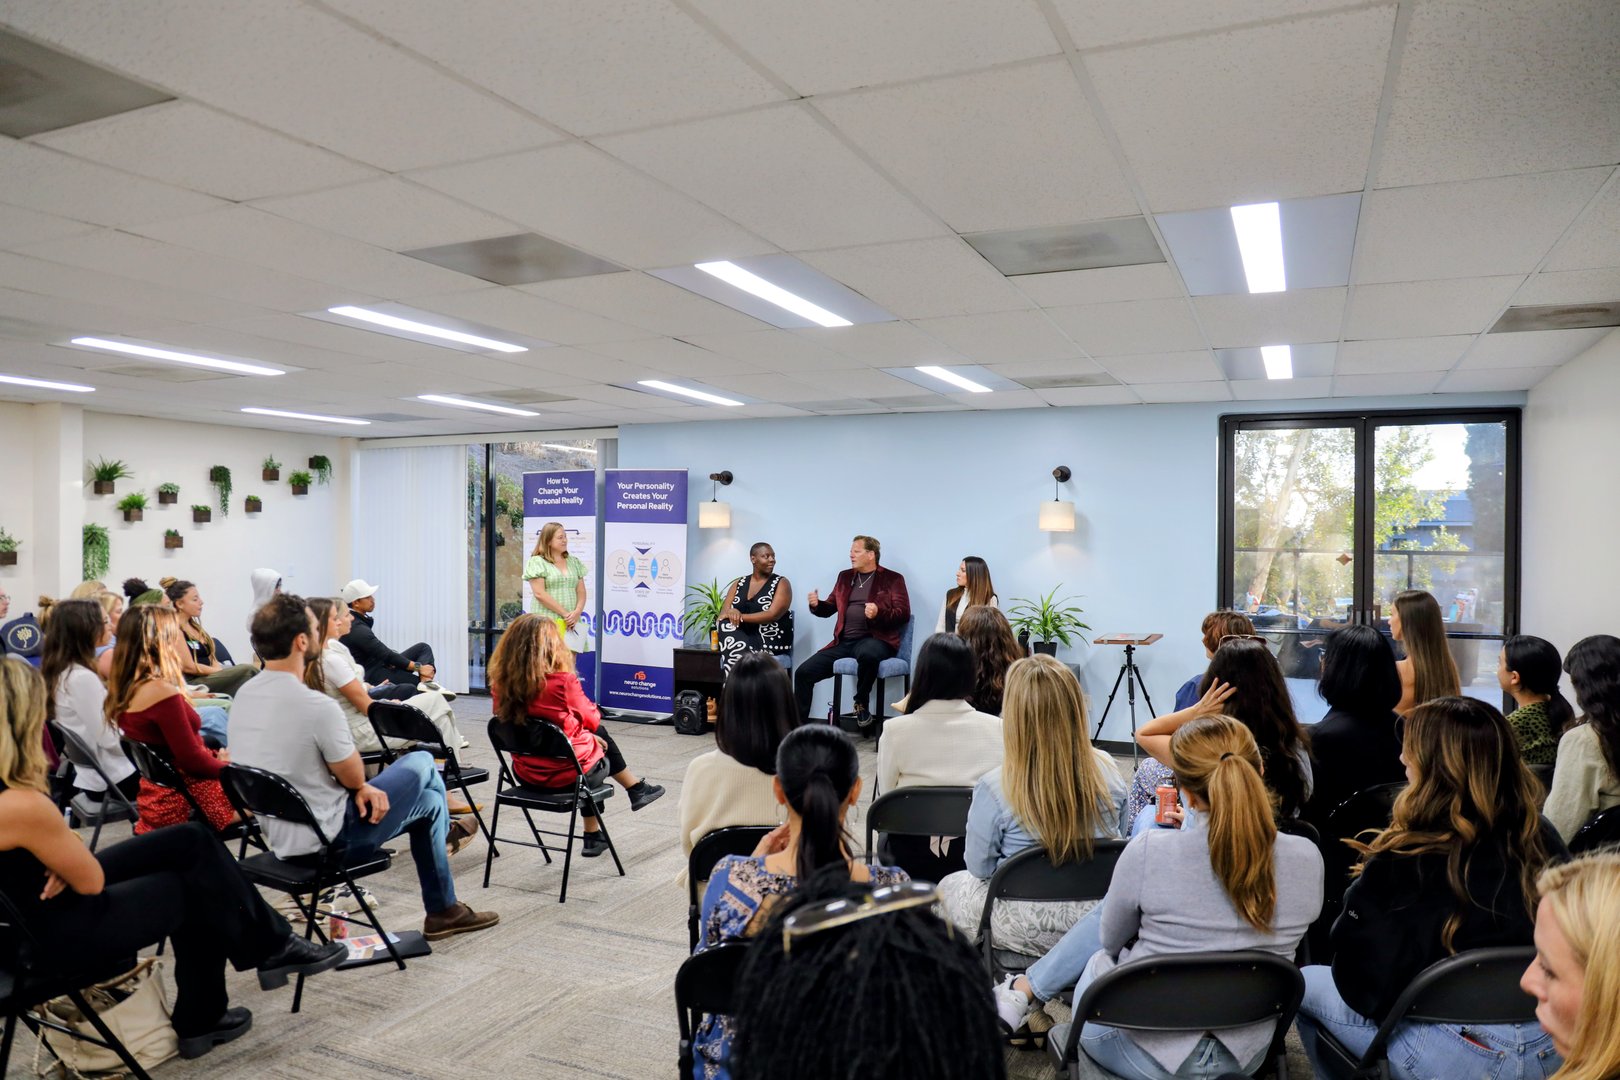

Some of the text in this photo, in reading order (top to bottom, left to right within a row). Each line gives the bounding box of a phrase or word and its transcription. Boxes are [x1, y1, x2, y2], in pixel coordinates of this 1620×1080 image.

[634, 482, 675, 491] Personality
[538, 487, 563, 496] Change
[561, 497, 584, 505] Reality
[648, 502, 674, 511] Reality
